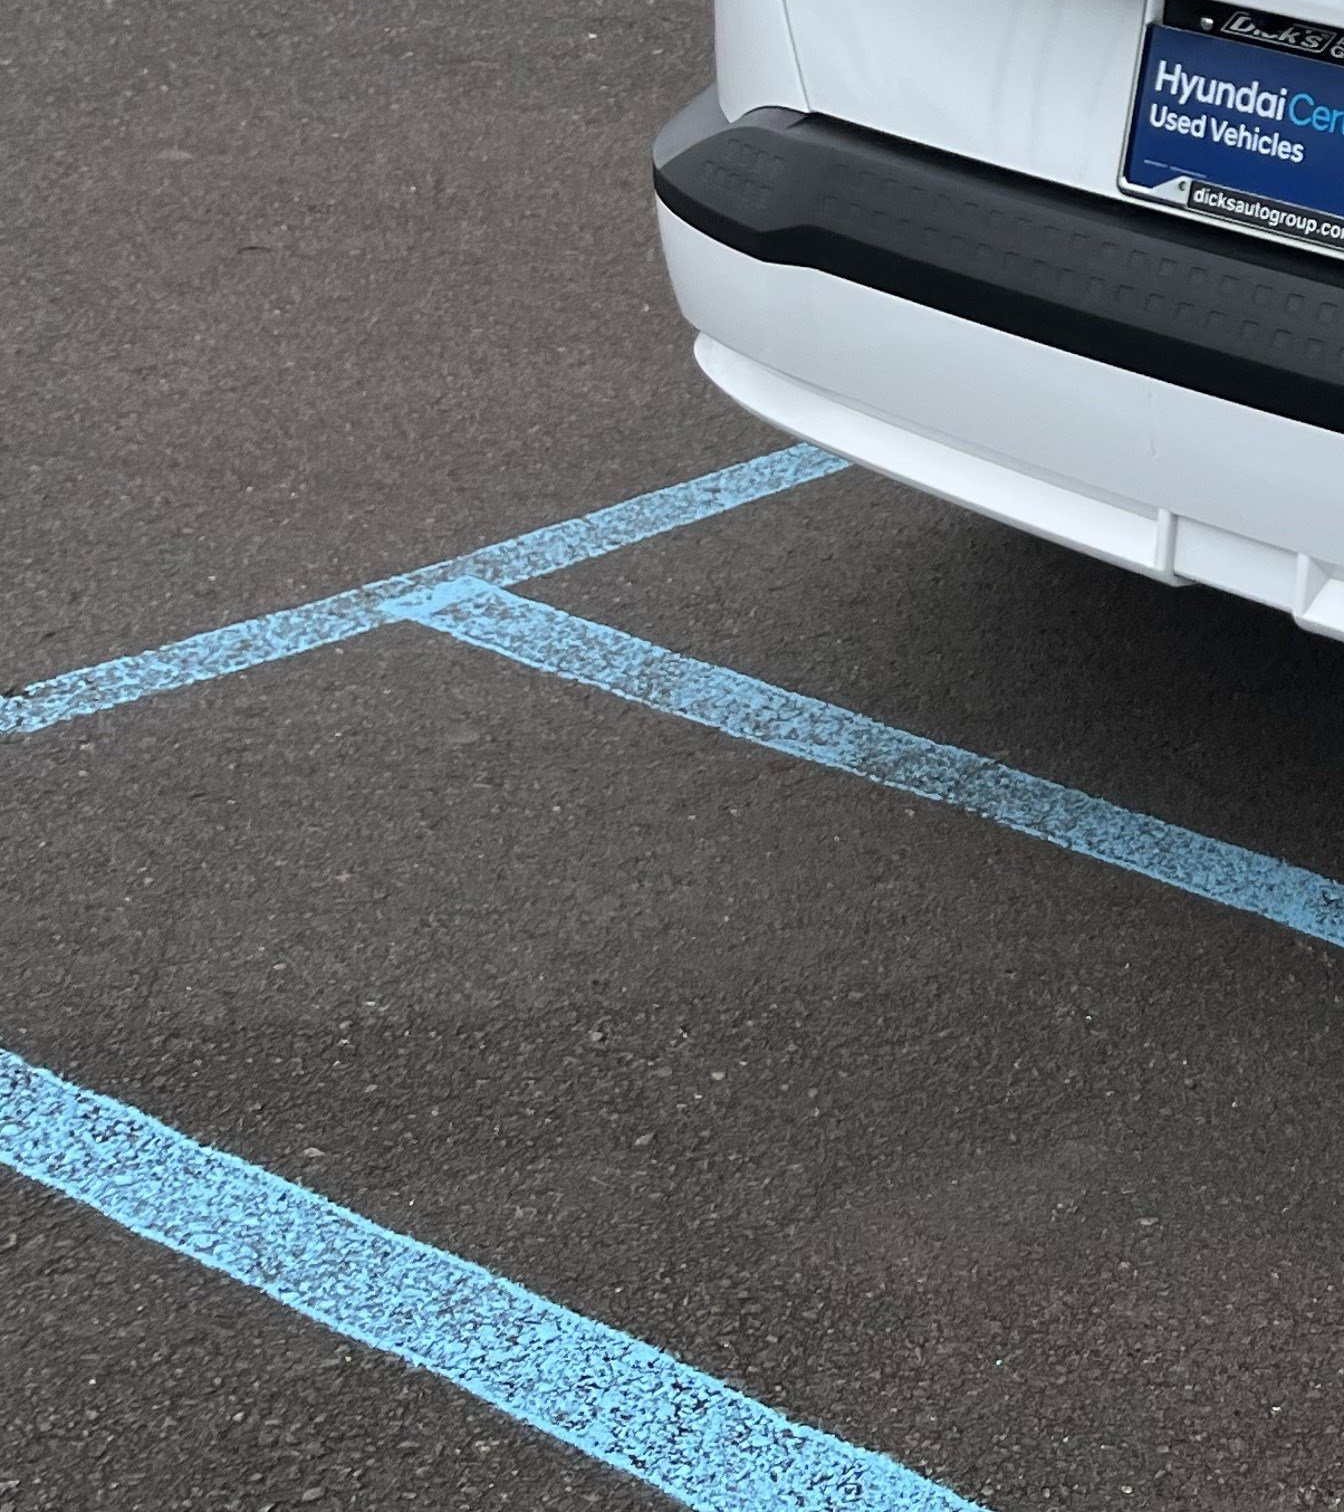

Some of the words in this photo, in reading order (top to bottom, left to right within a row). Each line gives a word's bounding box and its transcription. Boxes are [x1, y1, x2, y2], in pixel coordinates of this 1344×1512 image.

[1229, 16, 1323, 49] Dick's
[1154, 59, 1288, 122] Hyundai
[1149, 102, 1207, 139] Used
[1210, 117, 1305, 163] Vehicles
